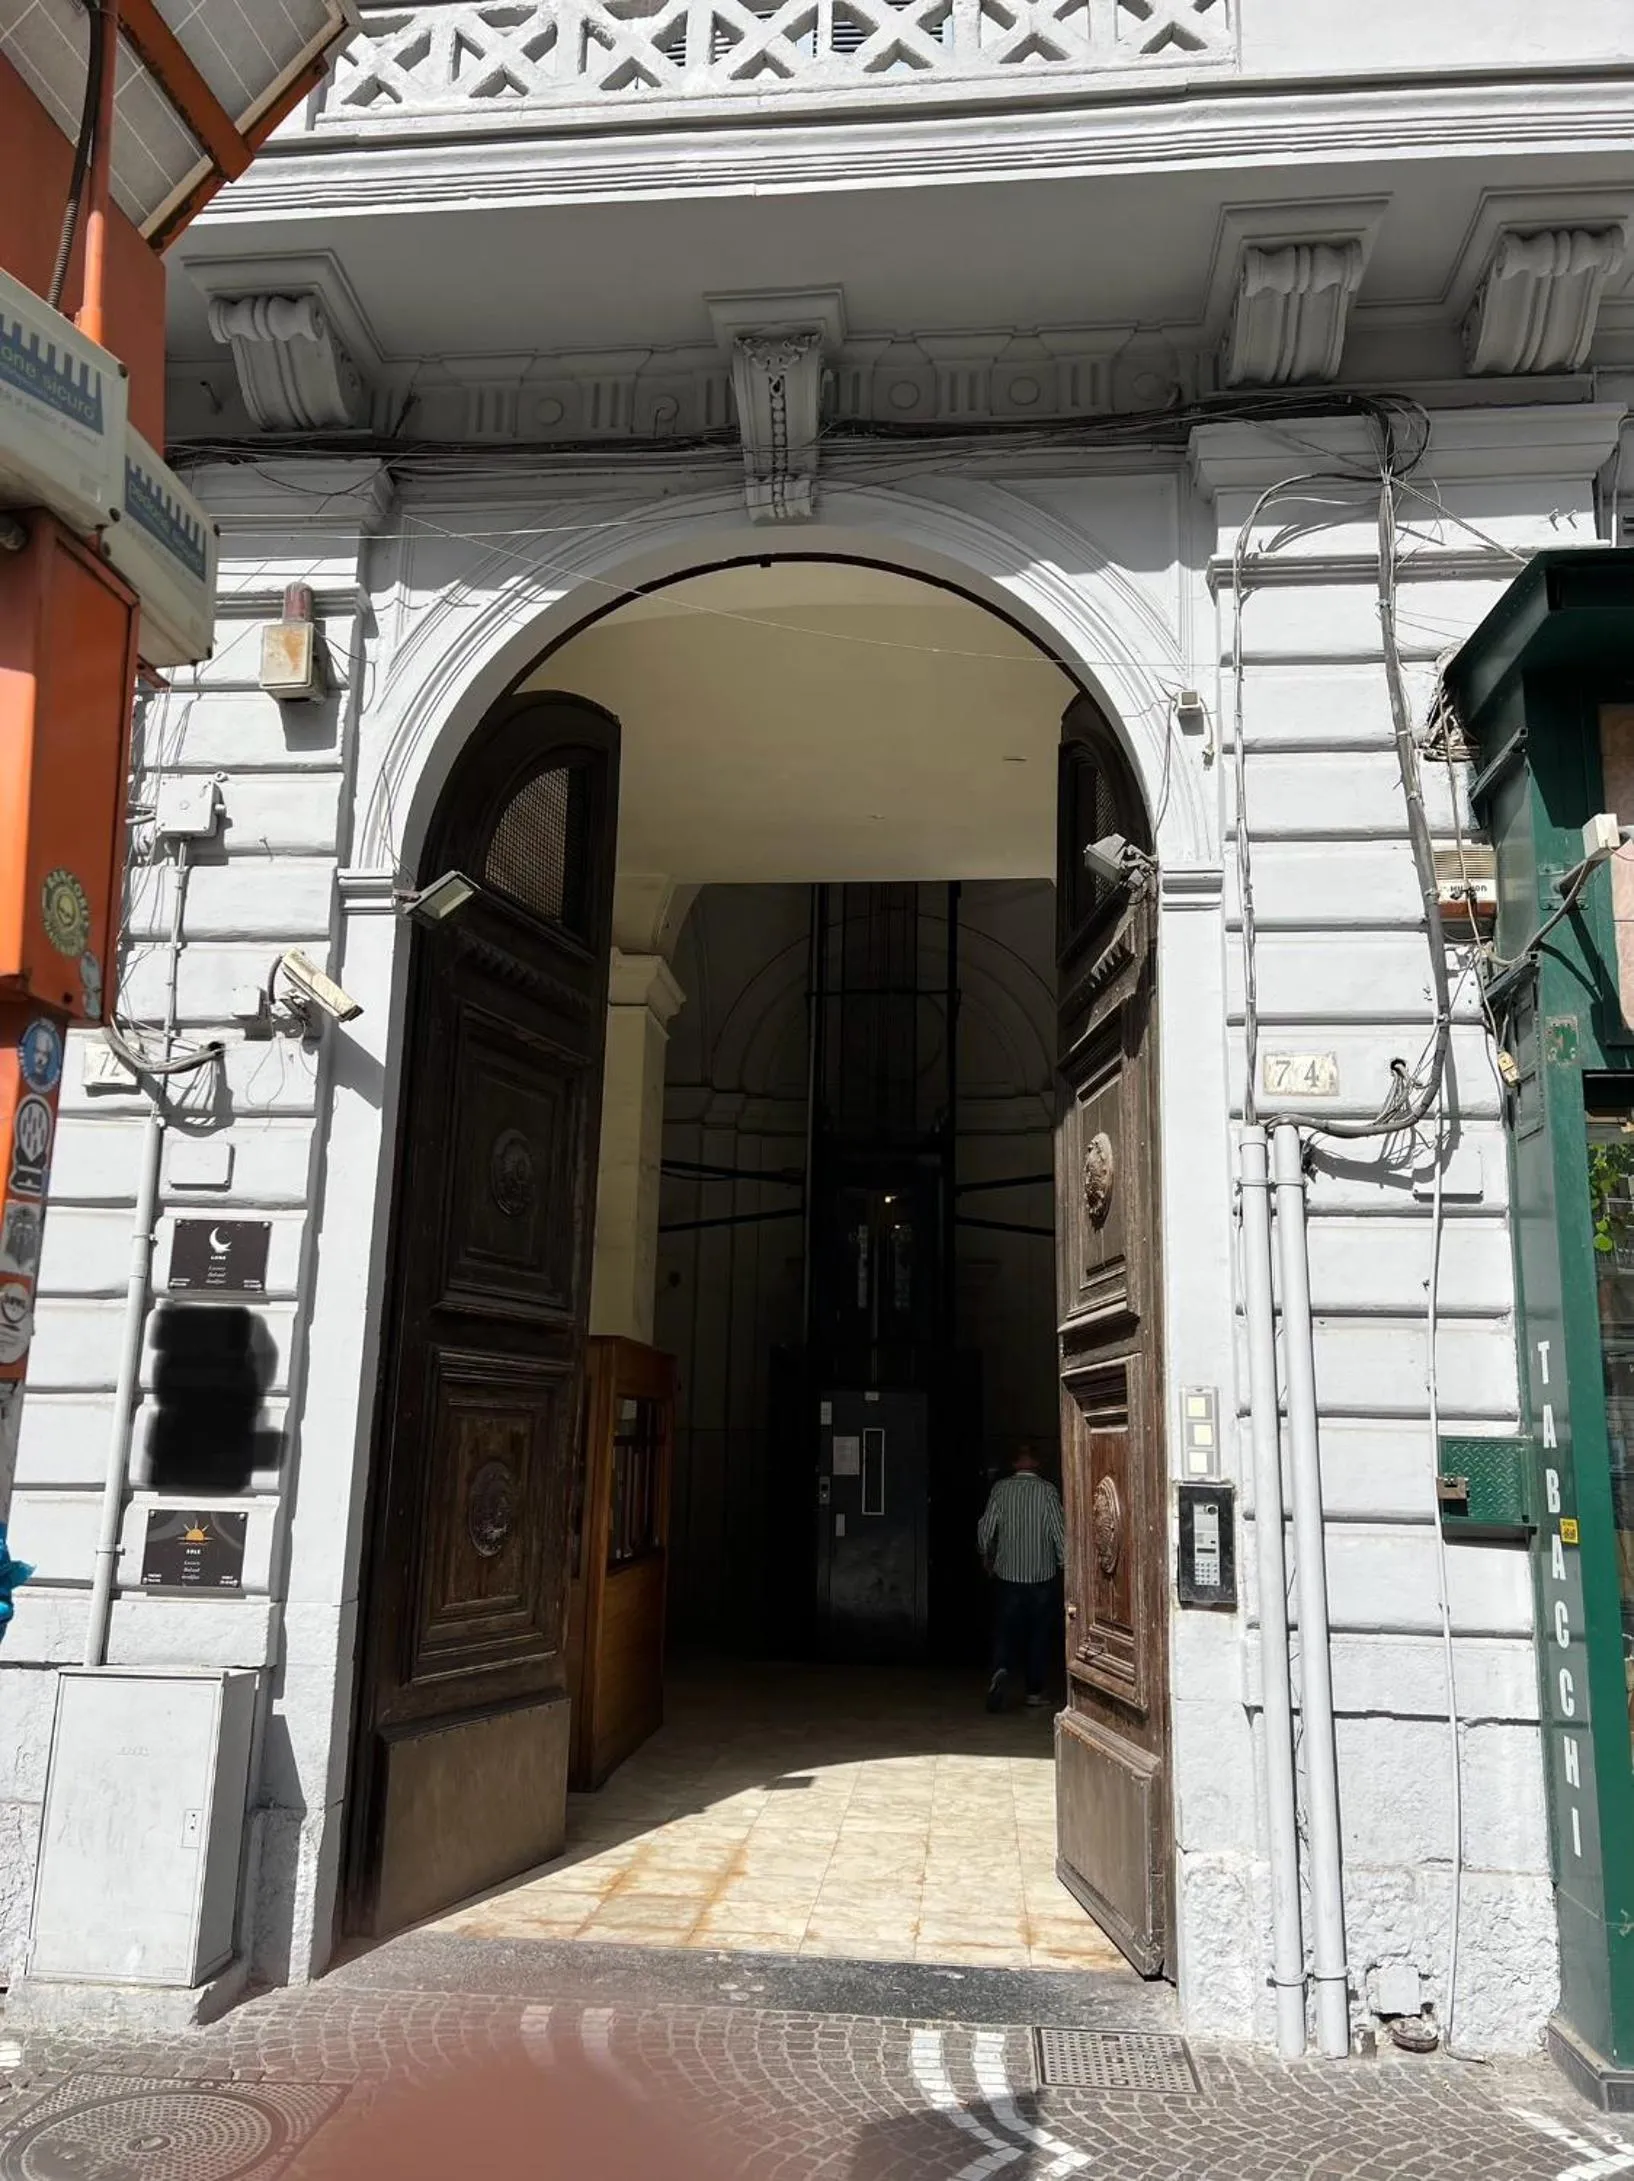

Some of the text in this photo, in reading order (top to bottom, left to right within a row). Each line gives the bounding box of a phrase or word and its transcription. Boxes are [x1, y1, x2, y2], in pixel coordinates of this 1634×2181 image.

[99, 1051, 120, 1076] 72
[1275, 1059, 1320, 1088] 74
[1537, 1340, 1582, 1857] TABACCHI
